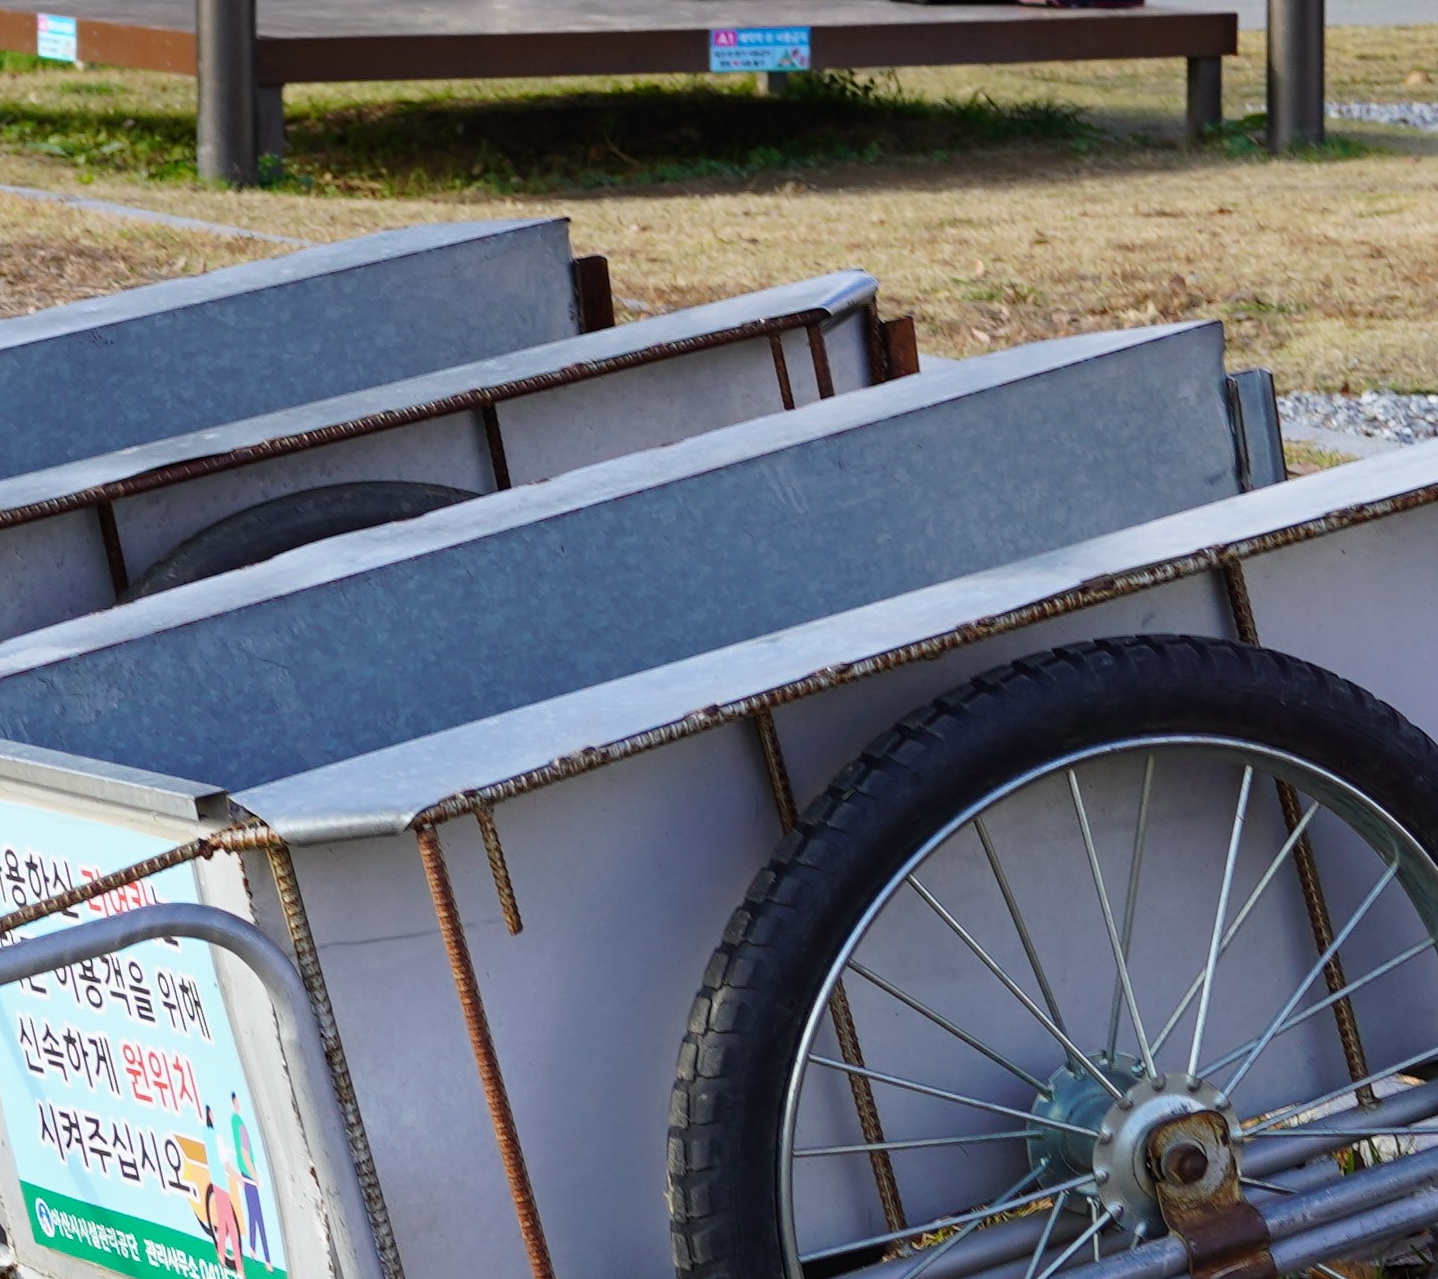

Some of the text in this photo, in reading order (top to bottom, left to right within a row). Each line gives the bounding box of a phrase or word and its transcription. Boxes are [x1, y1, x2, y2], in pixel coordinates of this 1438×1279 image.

[717, 32, 736, 45] A1
[54, 953, 156, 1023] 이용객을
[157, 972, 212, 1040] 위해
[19, 1017, 203, 1119] 신속하게 원위치
[38, 1103, 198, 1197] 시켜주십시오.
[145, 1238, 201, 1279] 관리사무소
